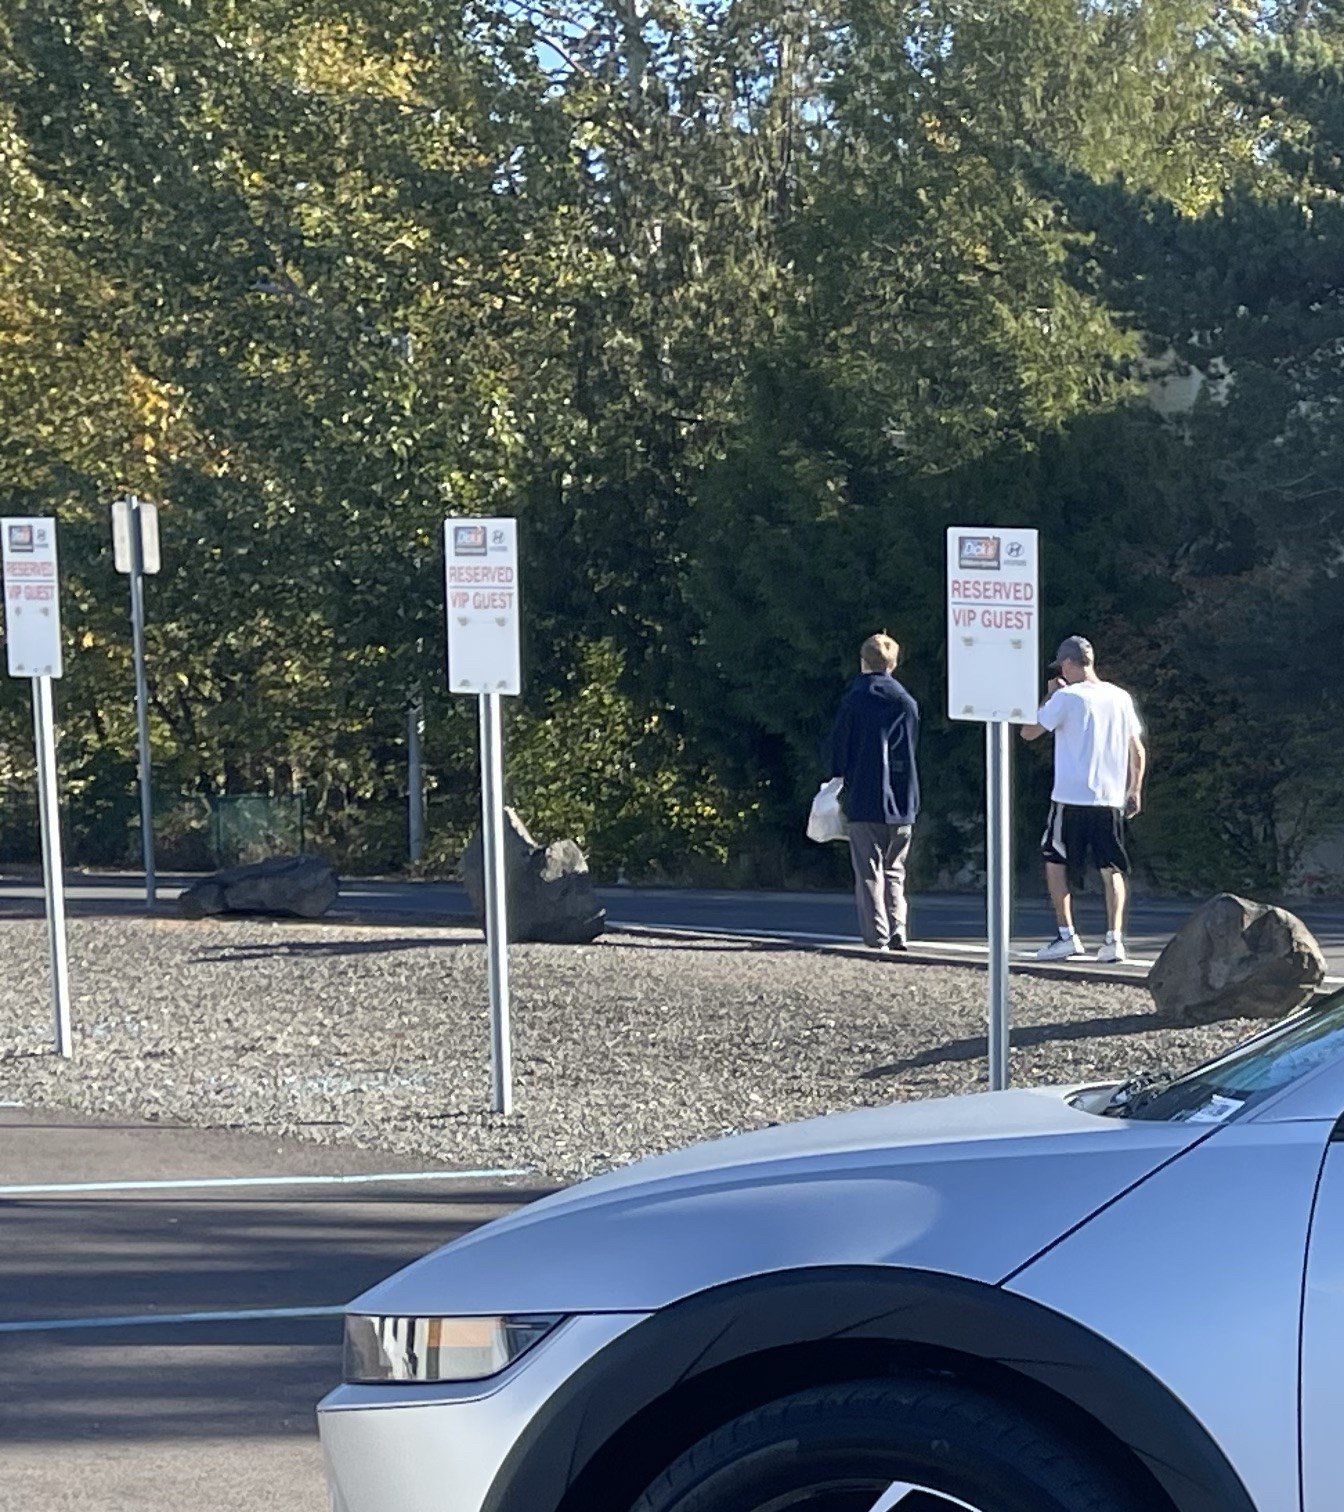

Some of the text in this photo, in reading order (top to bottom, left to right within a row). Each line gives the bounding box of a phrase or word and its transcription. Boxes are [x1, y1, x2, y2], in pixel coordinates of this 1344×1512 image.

[951, 580, 1034, 601] RESERVED
[953, 609, 1034, 630] VIP GUEST
